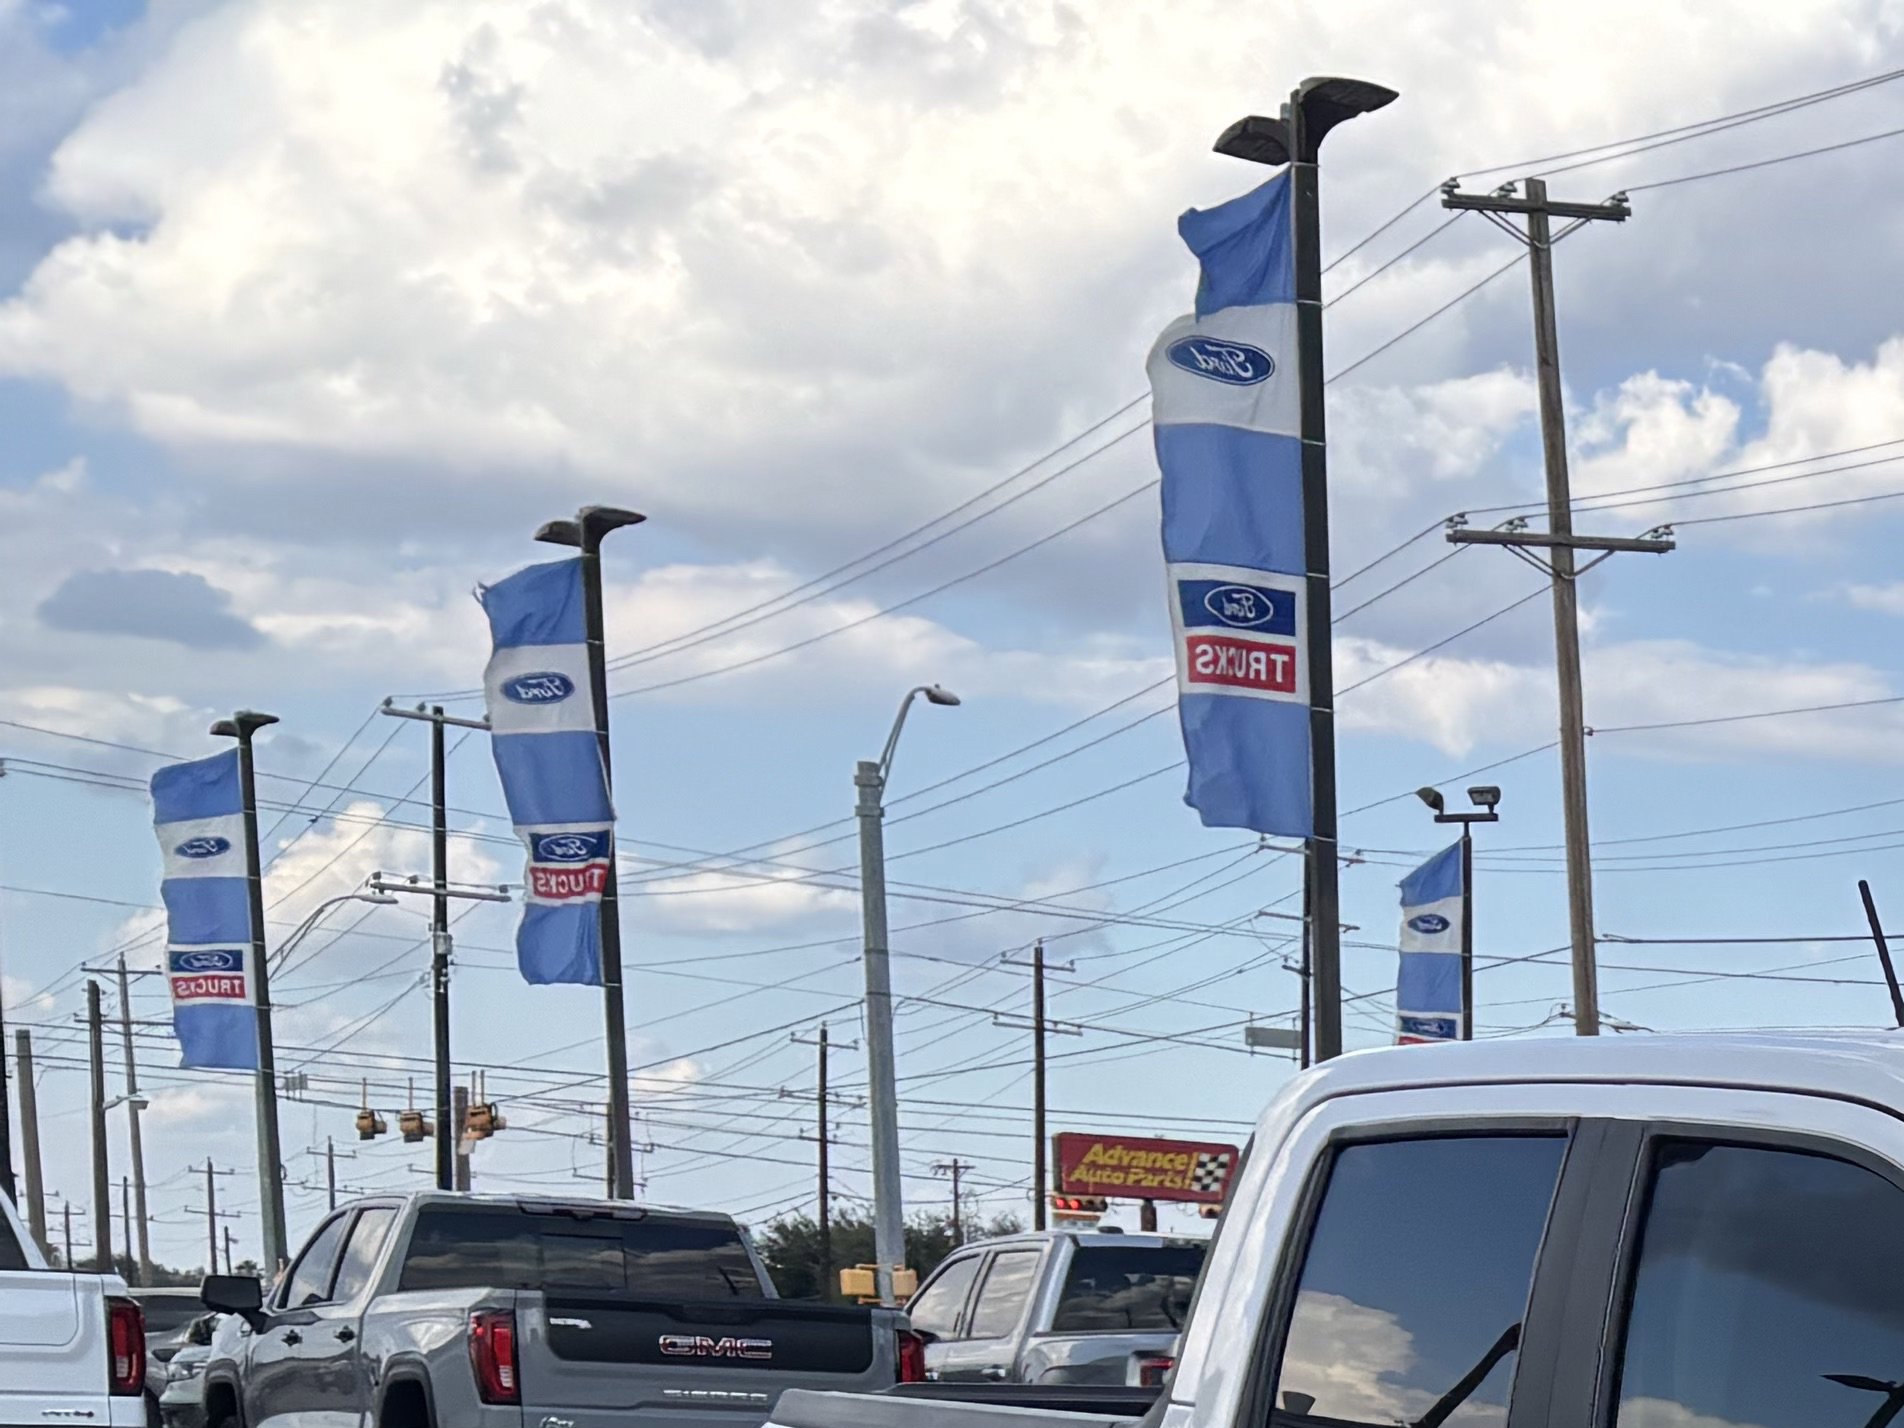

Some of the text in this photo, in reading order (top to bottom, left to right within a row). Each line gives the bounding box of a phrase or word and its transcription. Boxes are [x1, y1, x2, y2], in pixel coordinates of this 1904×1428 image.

[1082, 1143, 1189, 1171] Advance
[1070, 1164, 1184, 1189] Auto Parts
[659, 1334, 773, 1360] GMC
